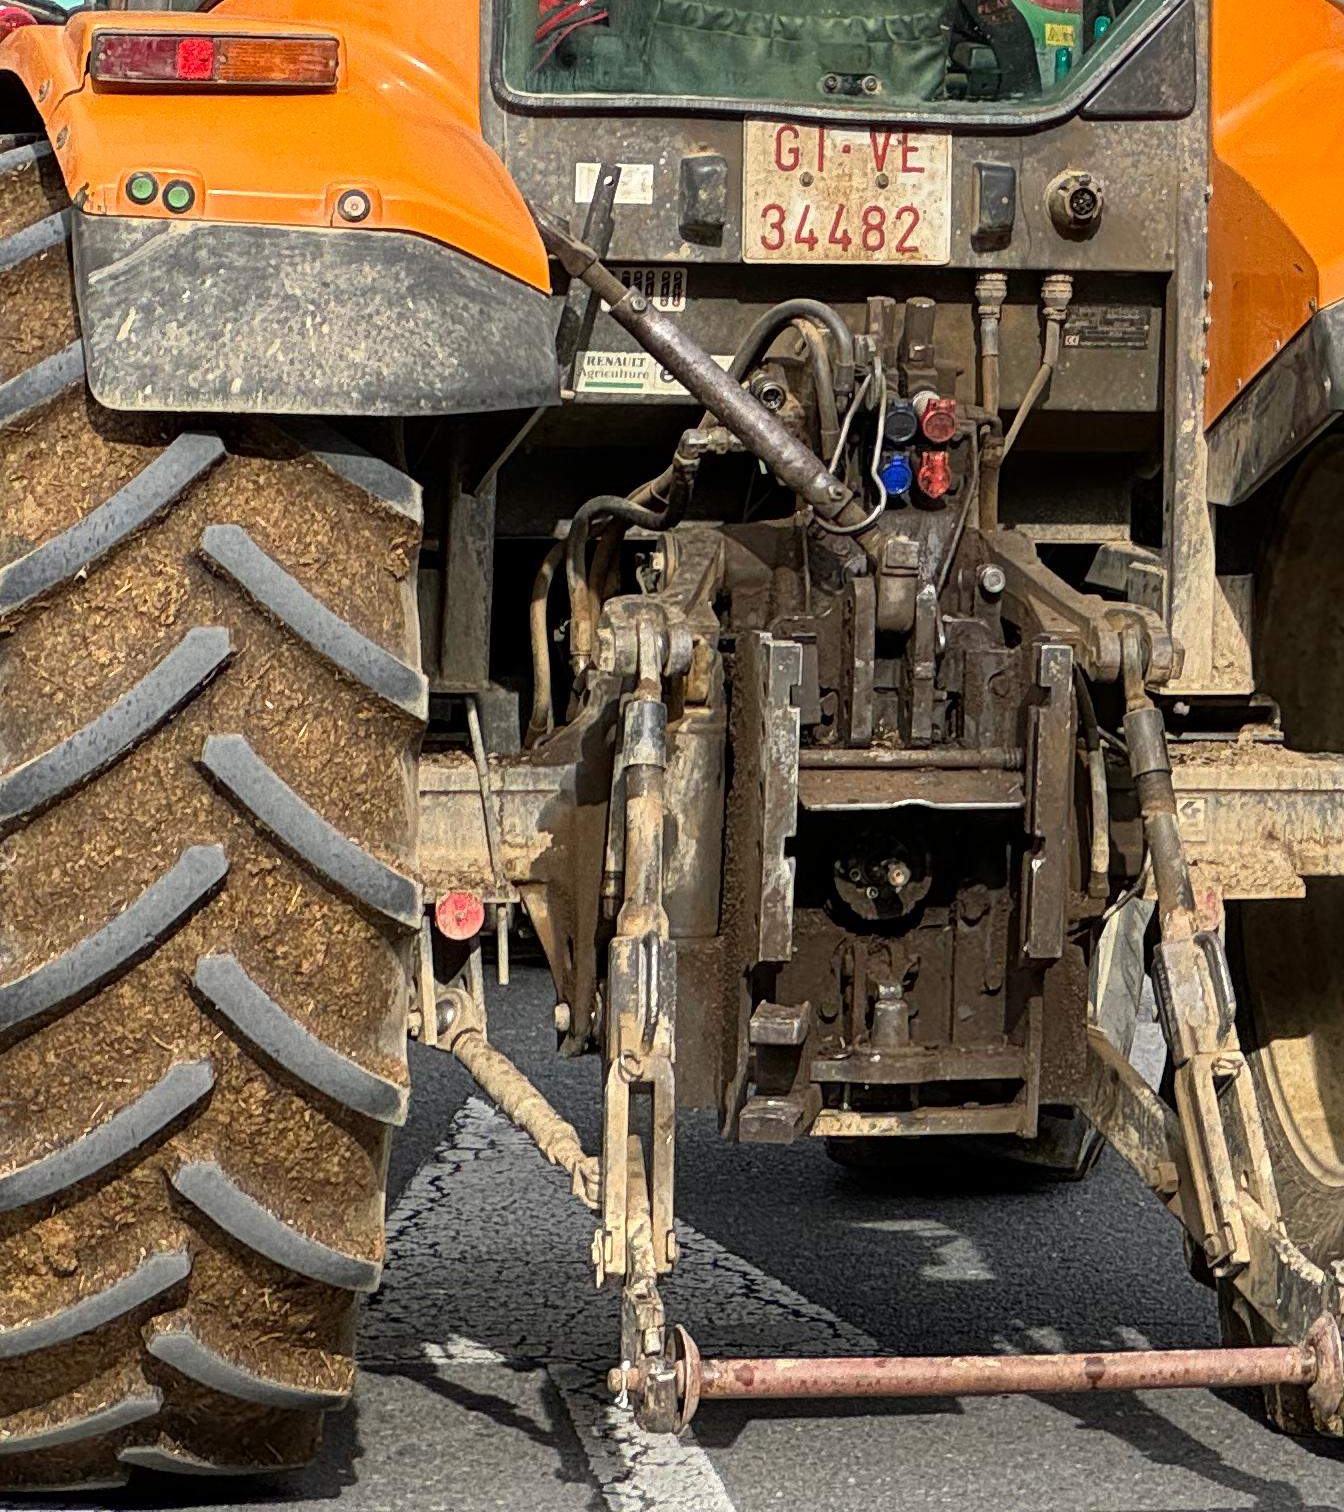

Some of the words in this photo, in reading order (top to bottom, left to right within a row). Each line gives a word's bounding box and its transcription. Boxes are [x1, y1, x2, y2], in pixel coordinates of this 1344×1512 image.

[760, 202, 921, 253] 34482
[586, 356, 646, 367] RENAULT
[579, 369, 650, 380] Agriculture
